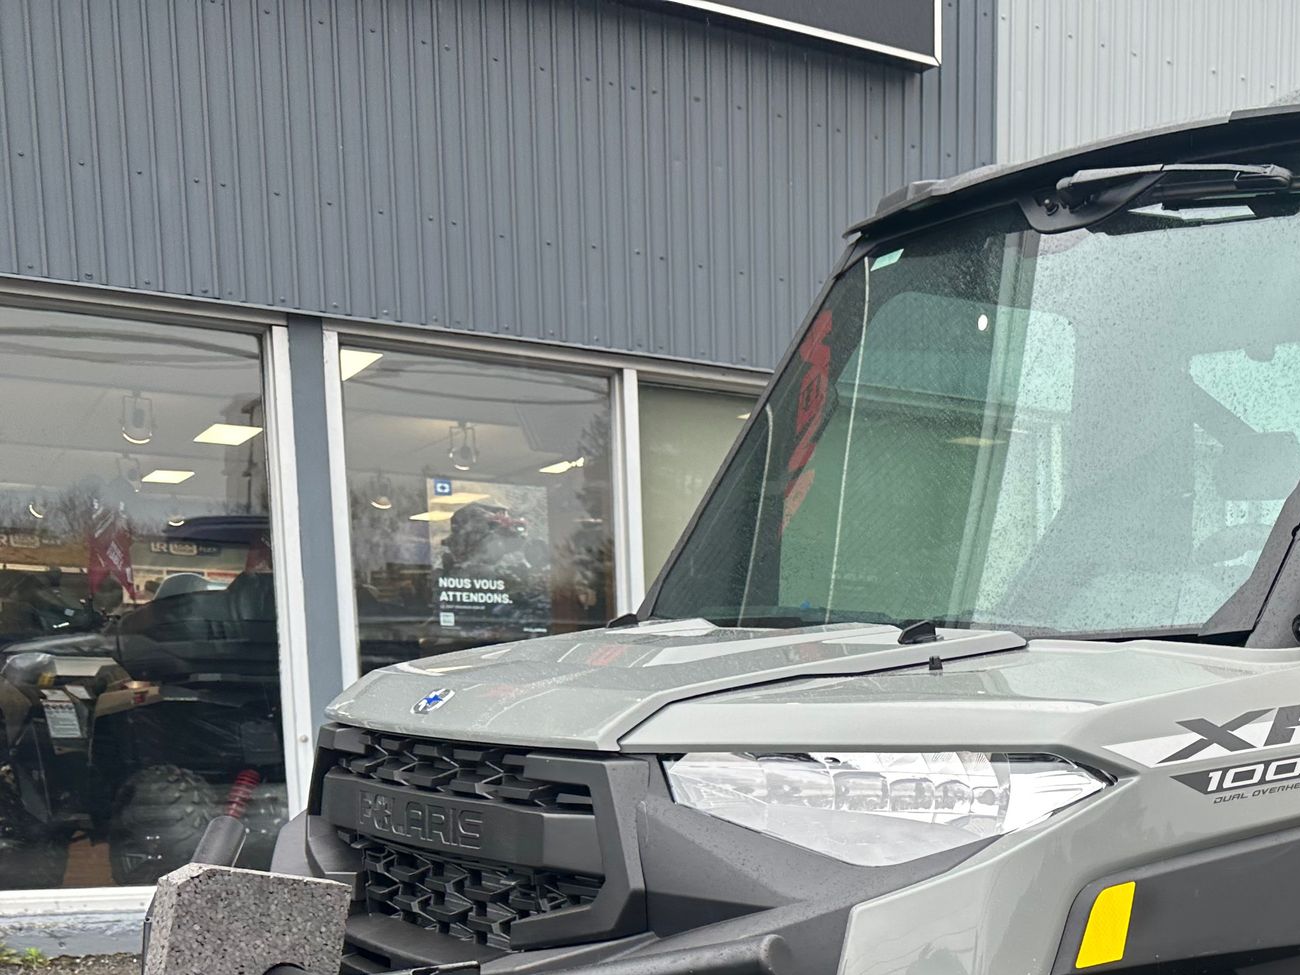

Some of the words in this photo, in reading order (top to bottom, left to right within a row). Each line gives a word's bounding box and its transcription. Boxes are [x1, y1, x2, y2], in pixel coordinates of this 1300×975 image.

[438, 577, 472, 589] NOUS
[473, 578, 505, 590] VOUS
[439, 591, 514, 604] ATTENDONS.
[1213, 793, 1248, 805] DUAL
[359, 789, 484, 850] POLARIS
